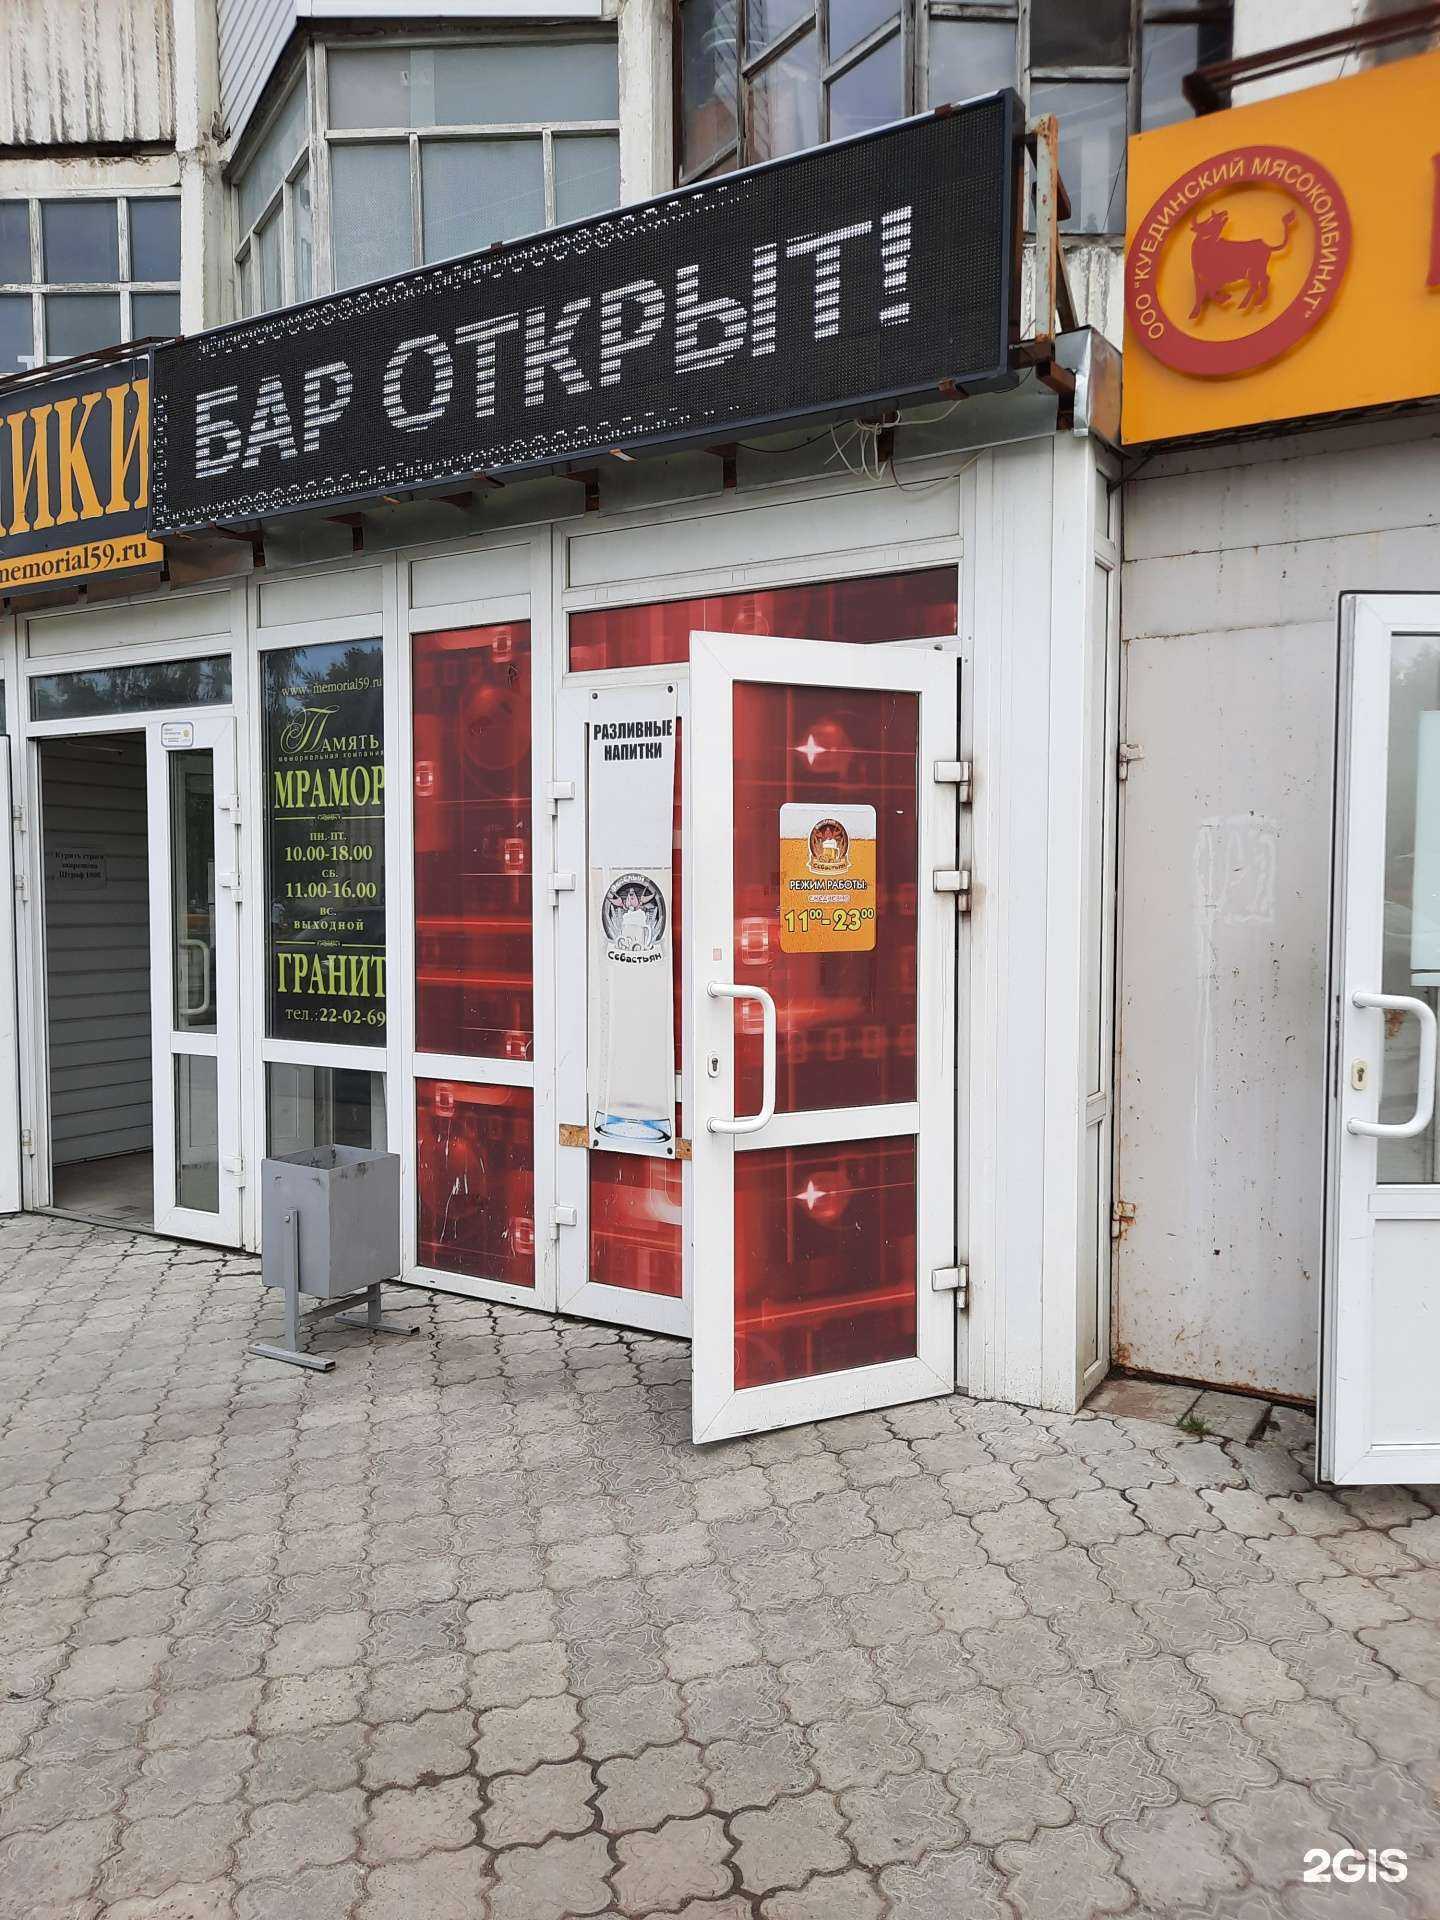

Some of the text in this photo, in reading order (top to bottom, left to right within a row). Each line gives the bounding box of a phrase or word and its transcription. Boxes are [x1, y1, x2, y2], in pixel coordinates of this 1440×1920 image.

[1134, 295, 1166, 340] ООО
[194, 205, 913, 480] БАР ОТКРЫТ!
[0, 377, 149, 538] ИКИ
[593, 719, 673, 741] РАЗЛИВНЫЕ
[604, 742, 663, 761] НАПИТКИ
[273, 765, 385, 810] МРАМОР
[285, 845, 373, 861] 10.00-18.00
[285, 880, 377, 898] 11.00-16.00
[790, 880, 826, 890] РЕЖИМ
[277, 953, 386, 998] ГРАНИТ
